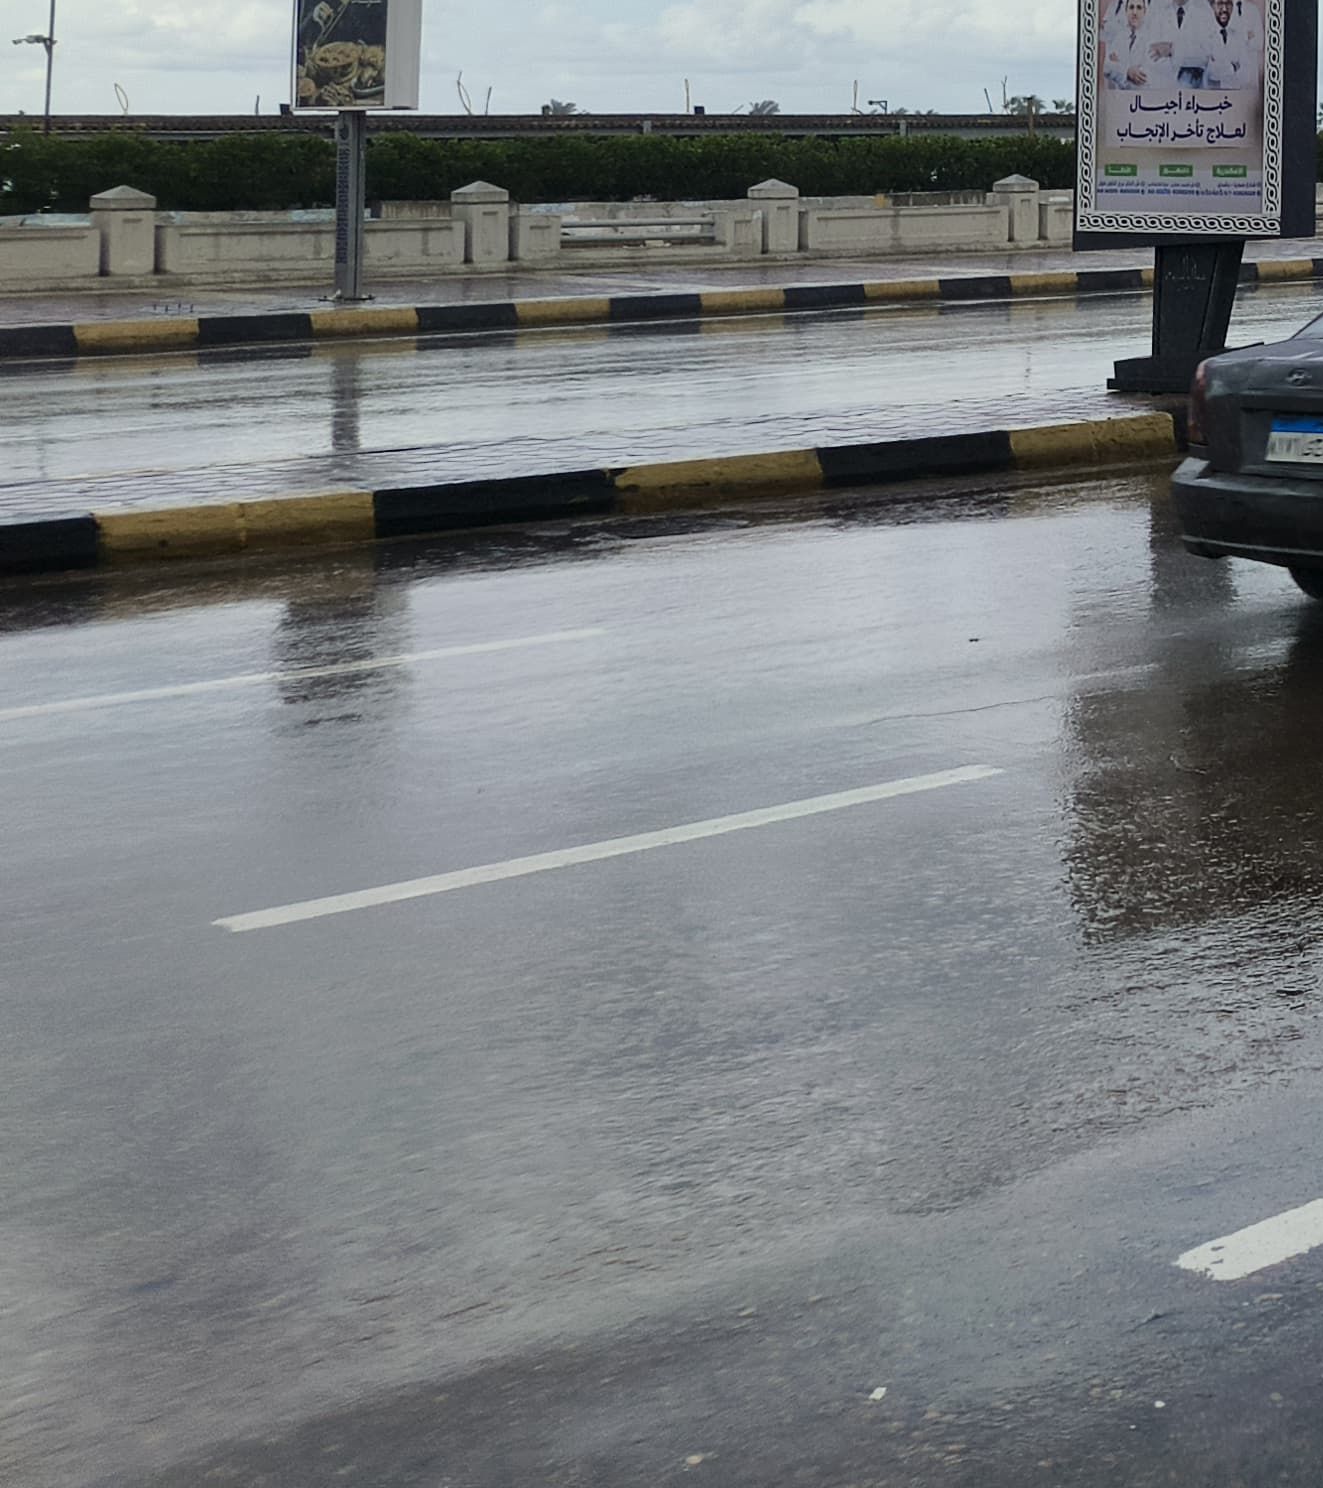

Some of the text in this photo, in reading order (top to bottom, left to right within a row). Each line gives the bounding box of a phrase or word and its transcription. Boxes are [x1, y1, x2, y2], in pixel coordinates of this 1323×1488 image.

[1129, 91, 1233, 114] خبراء أجيال
[1117, 118, 1246, 144] لعلاج تأخر الإنجاب
